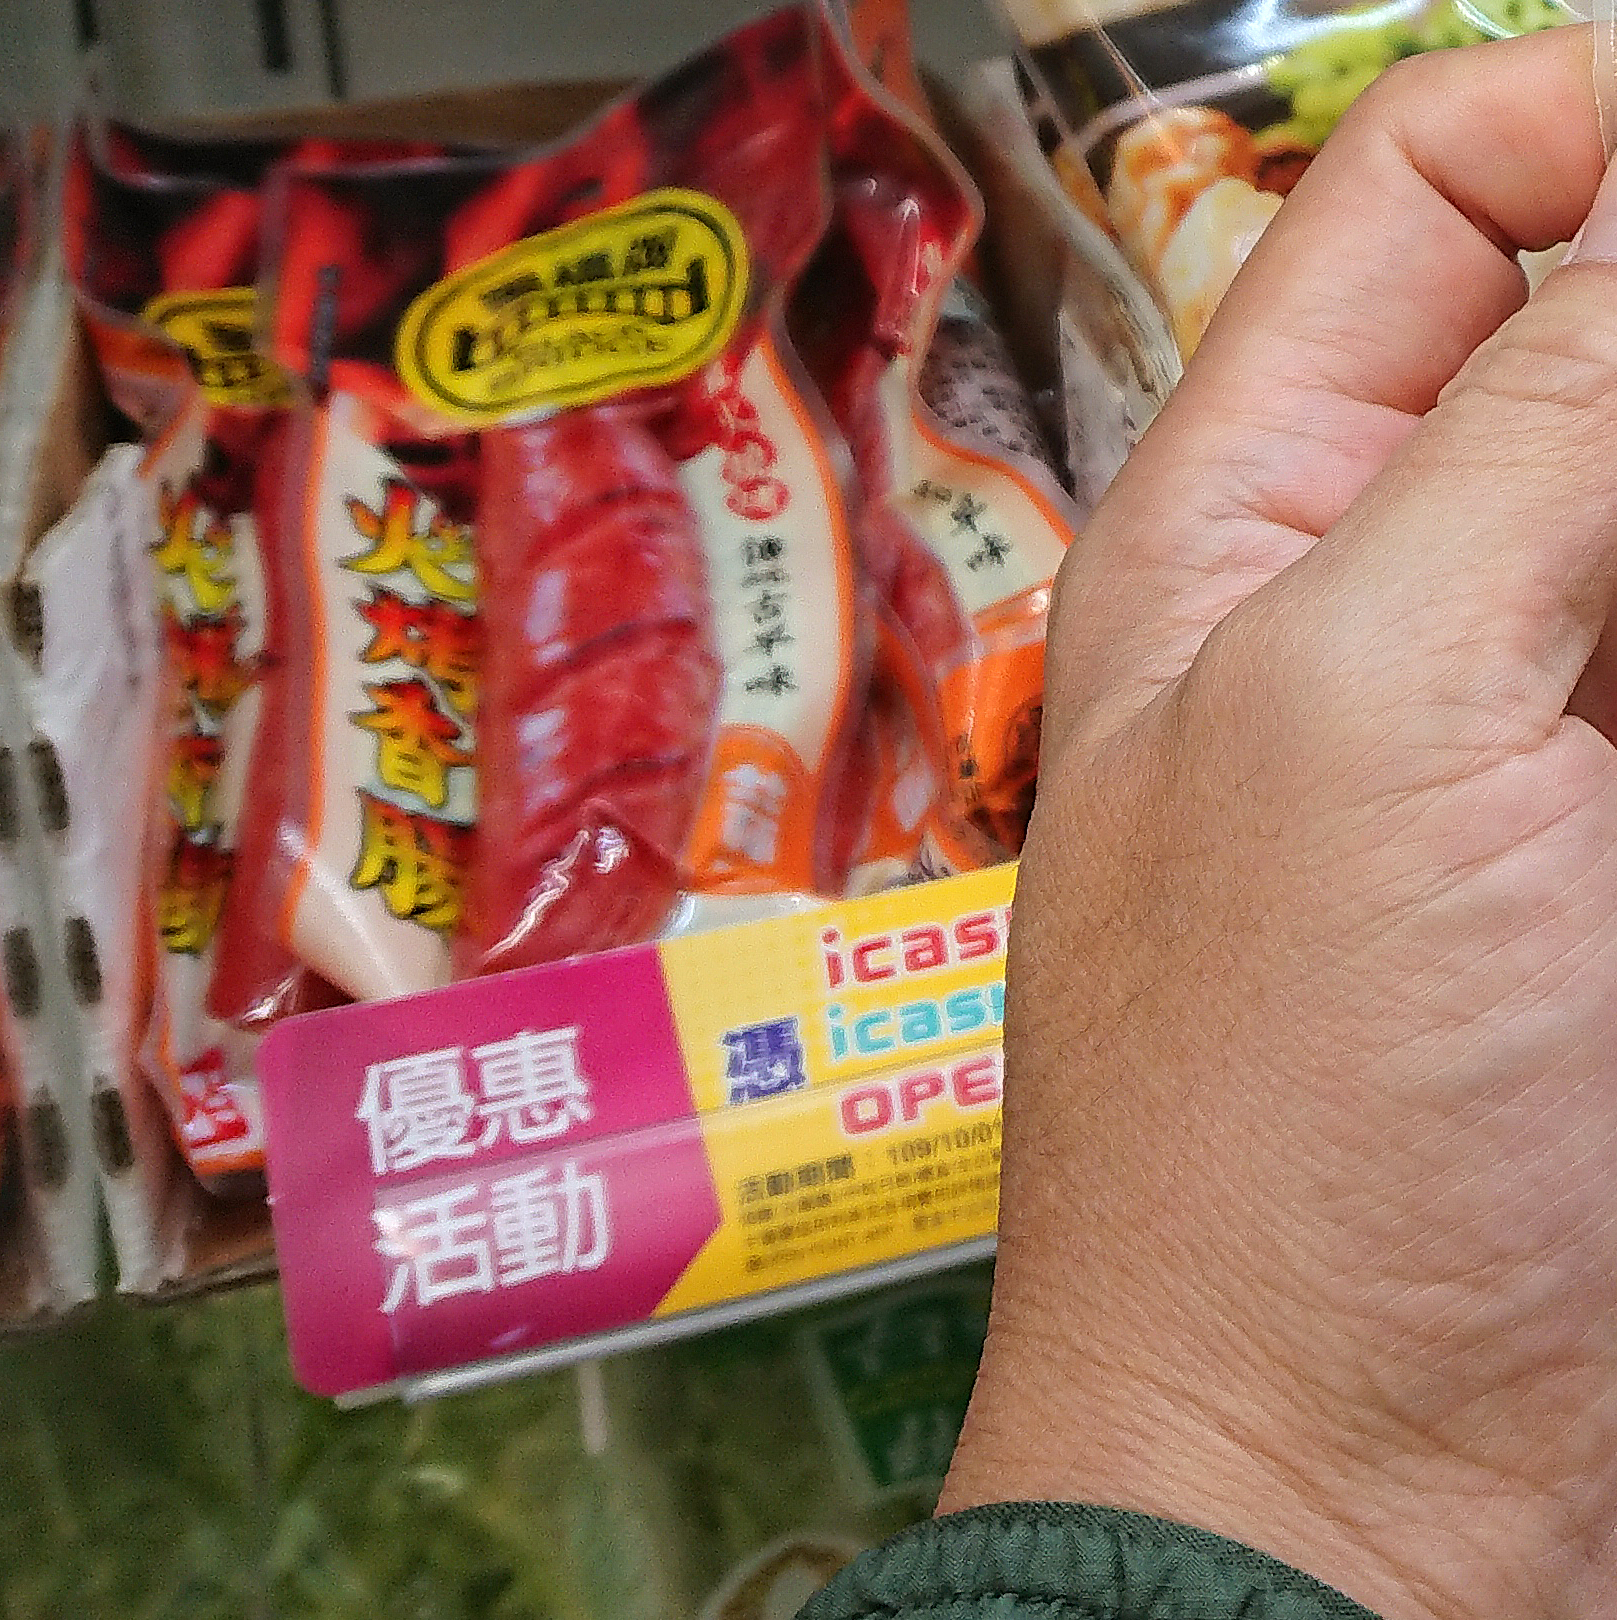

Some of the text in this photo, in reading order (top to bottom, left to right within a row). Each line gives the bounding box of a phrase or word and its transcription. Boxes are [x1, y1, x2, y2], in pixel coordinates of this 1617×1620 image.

[823, 906, 1013, 988] icas
[354, 1025, 592, 1177] 優惠
[373, 1159, 612, 1315] 活動
